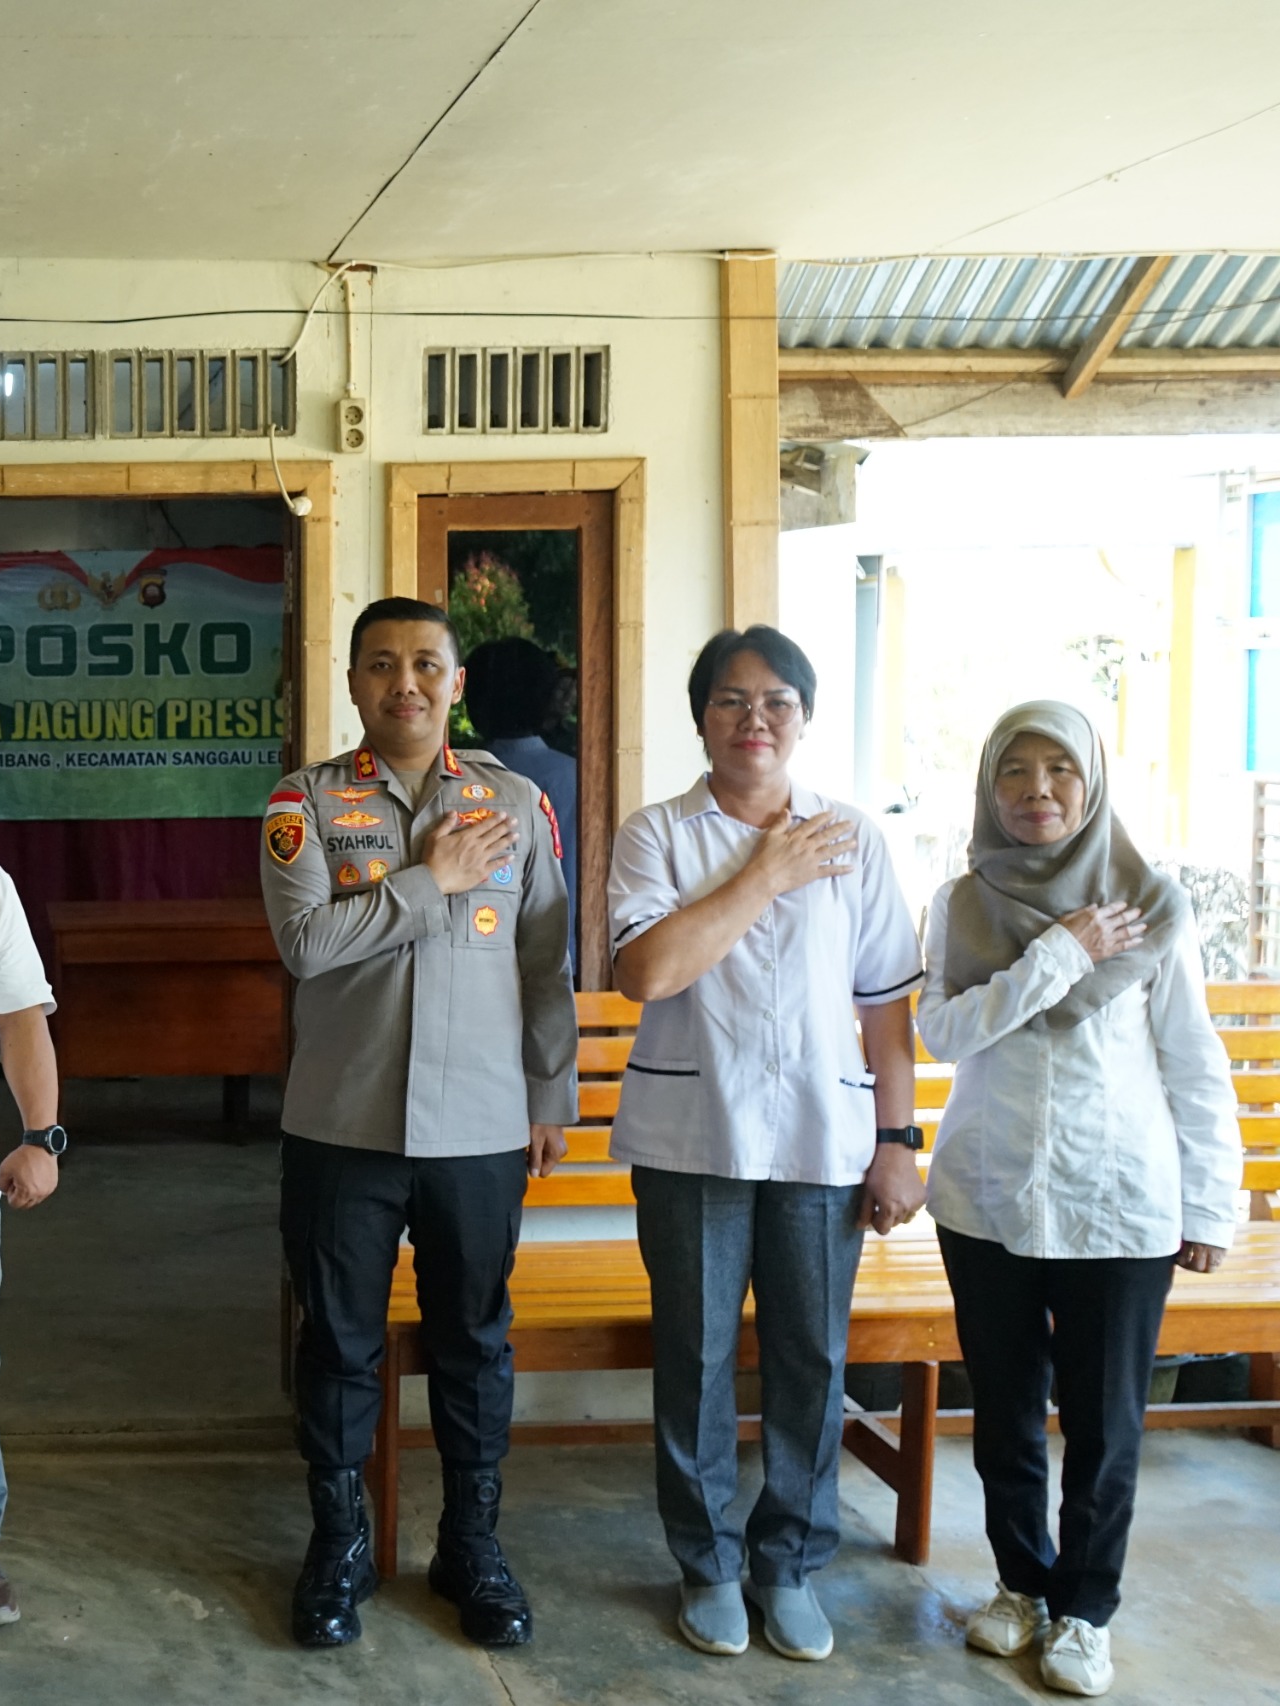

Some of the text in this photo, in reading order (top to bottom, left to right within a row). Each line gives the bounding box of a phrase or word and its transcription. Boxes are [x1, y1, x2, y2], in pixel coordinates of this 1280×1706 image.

[11, 700, 154, 740] JAGUNG
[66, 752, 167, 767] KECAMATAN
[172, 751, 252, 765] SANGGAU
[258, 750, 282, 764] LE
[327, 835, 393, 853] SYAHRUL
